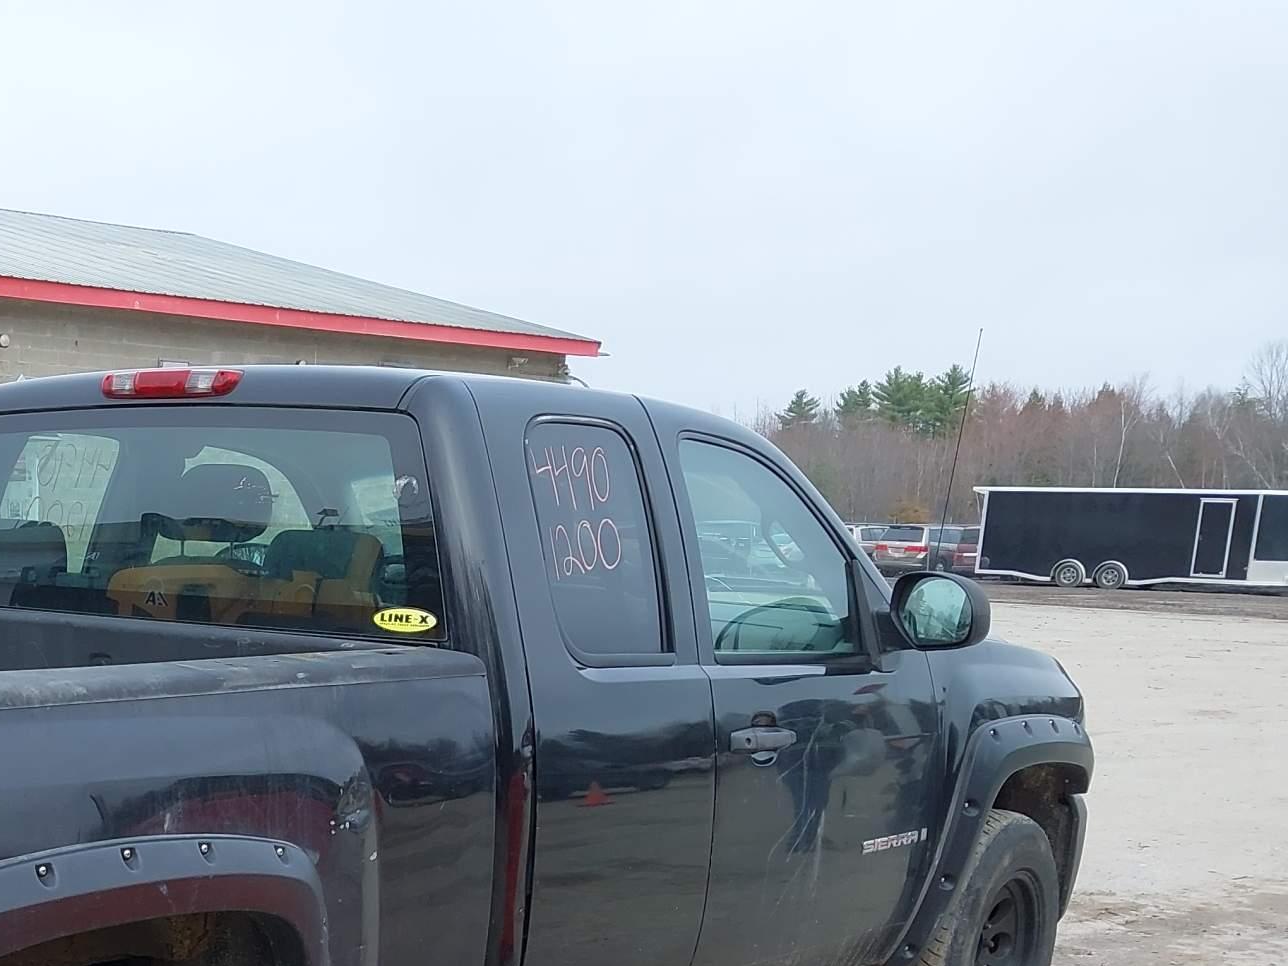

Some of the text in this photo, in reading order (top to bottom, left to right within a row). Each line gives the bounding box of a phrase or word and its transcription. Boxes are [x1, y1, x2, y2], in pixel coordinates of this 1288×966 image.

[529, 445, 610, 511] 4490
[549, 518, 621, 581] 1200
[379, 612, 430, 625] LINE-X
[862, 829, 919, 857] SIERRA
